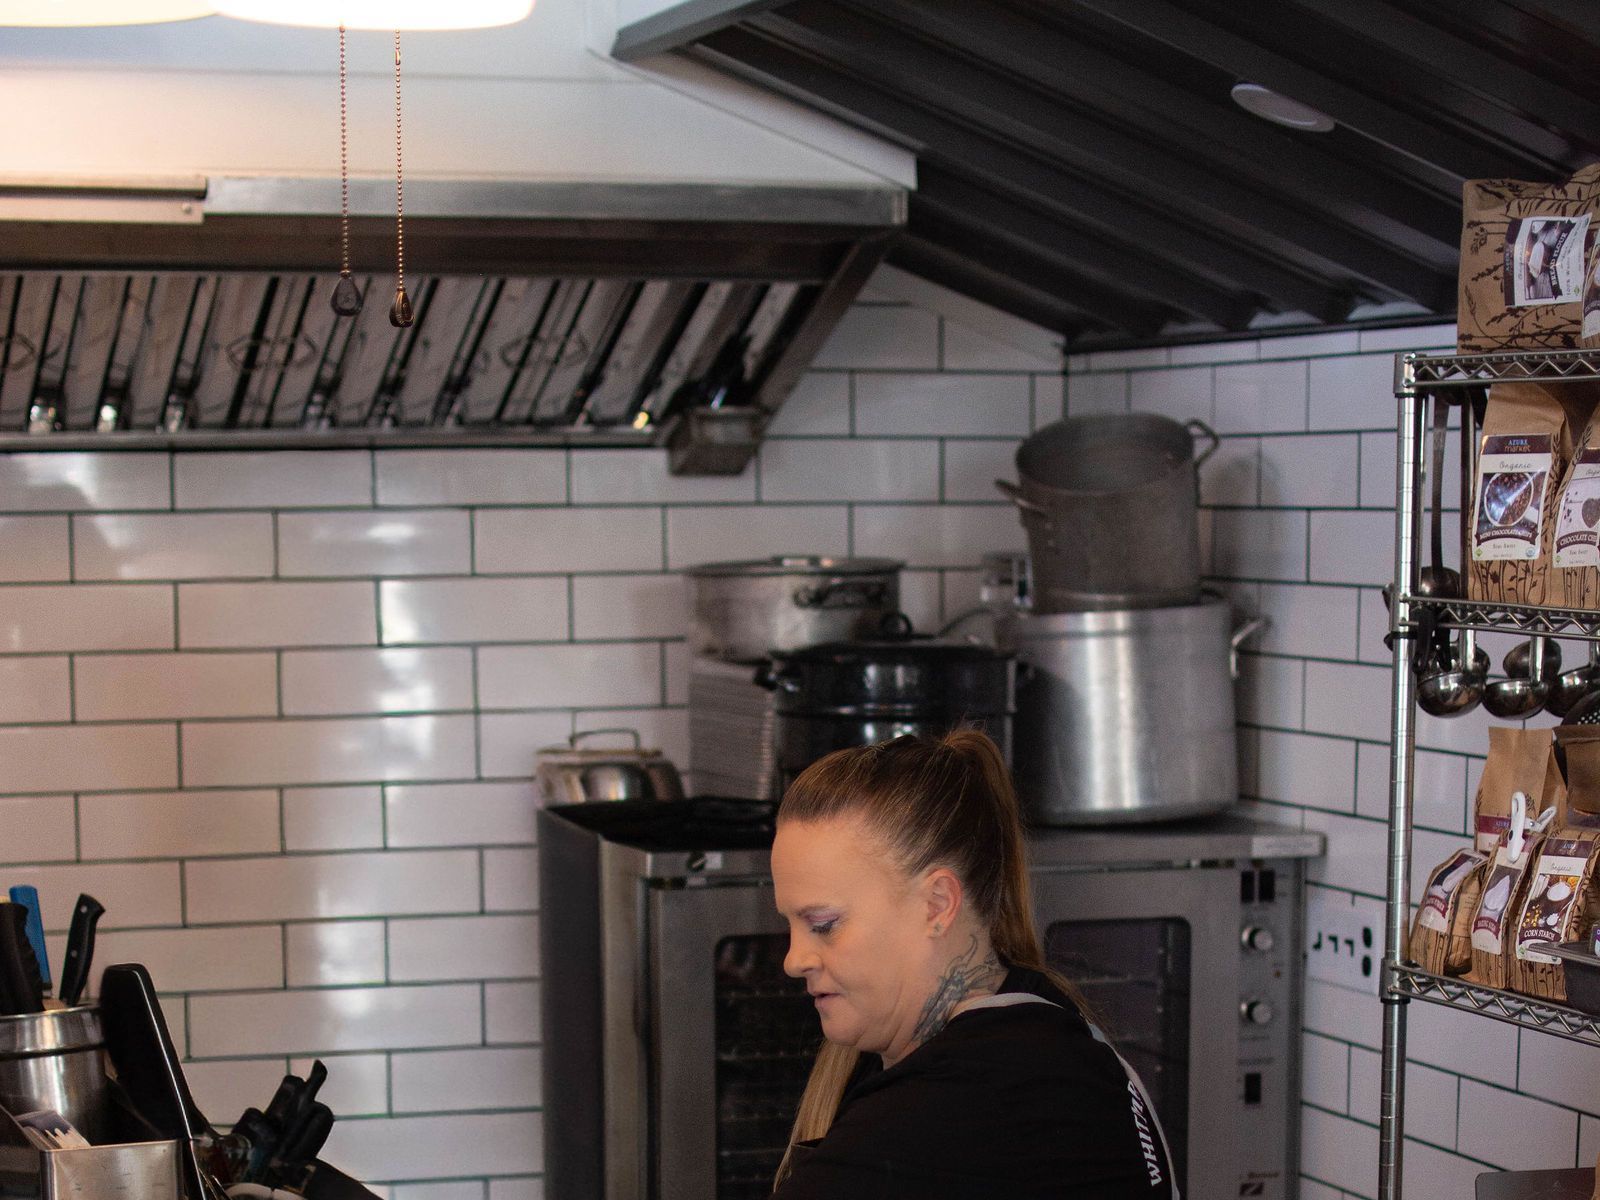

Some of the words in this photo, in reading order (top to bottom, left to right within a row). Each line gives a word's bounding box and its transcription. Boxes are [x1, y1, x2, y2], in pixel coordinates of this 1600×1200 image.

[1553, 232, 1568, 257] FLOUR
[1550, 259, 1558, 286] BREAD
[1504, 445, 1531, 453] market
[1499, 461, 1531, 471] Organic
[1491, 528, 1519, 536] CHOCOLATE
[1560, 534, 1587, 546] CHOCOLATE
[1524, 928, 1538, 938] CORN
[1537, 927, 1556, 941] STARCH
